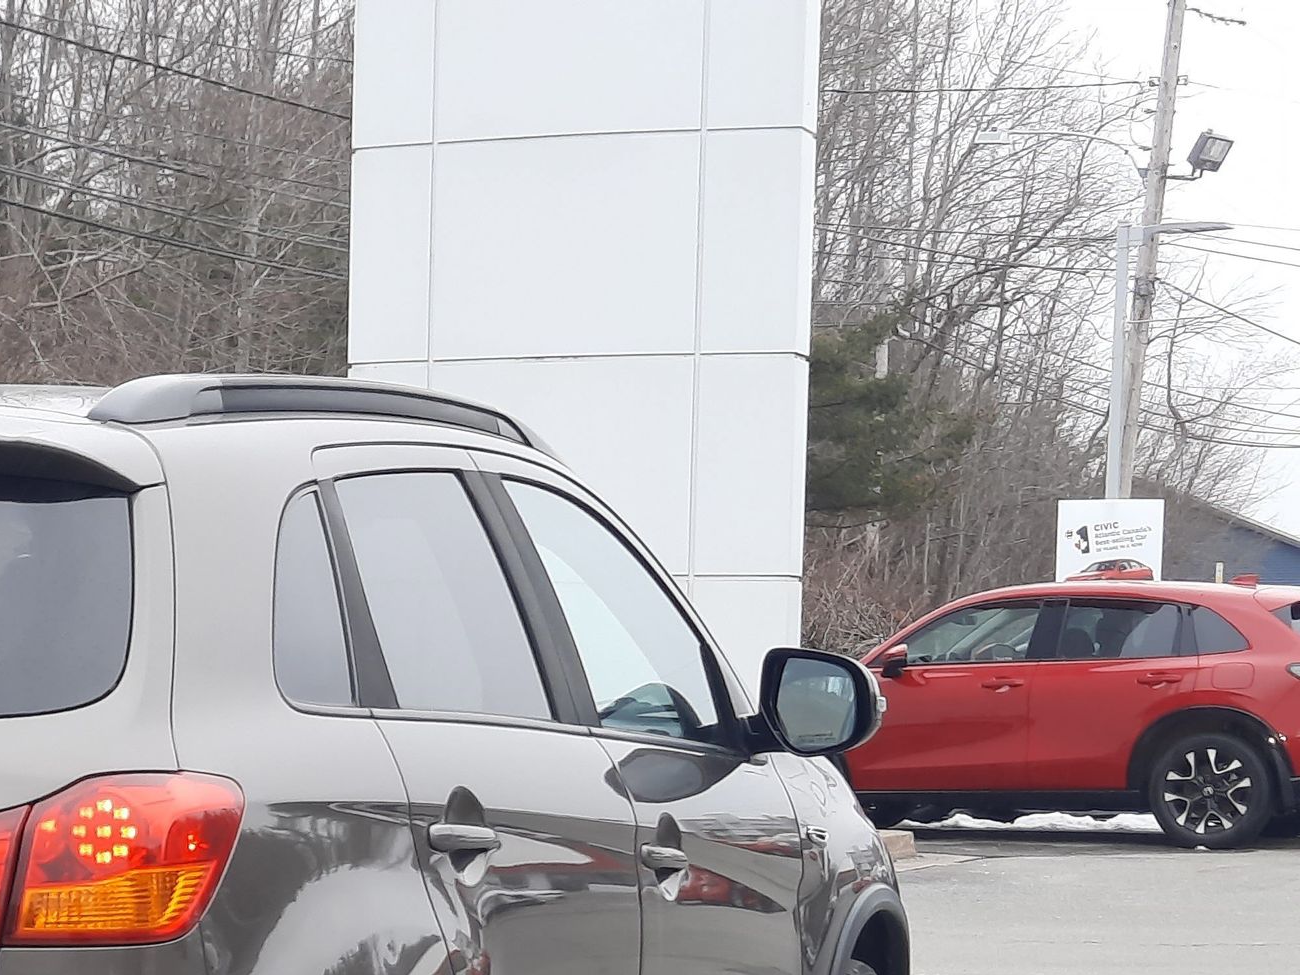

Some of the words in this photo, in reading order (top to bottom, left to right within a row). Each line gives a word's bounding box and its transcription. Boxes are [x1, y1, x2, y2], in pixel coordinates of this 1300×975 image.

[1094, 522, 1119, 532] CIVIC
[1095, 530, 1120, 539] Atlantic
[1122, 526, 1152, 535] Canada's
[1095, 535, 1134, 546] Best-selling
